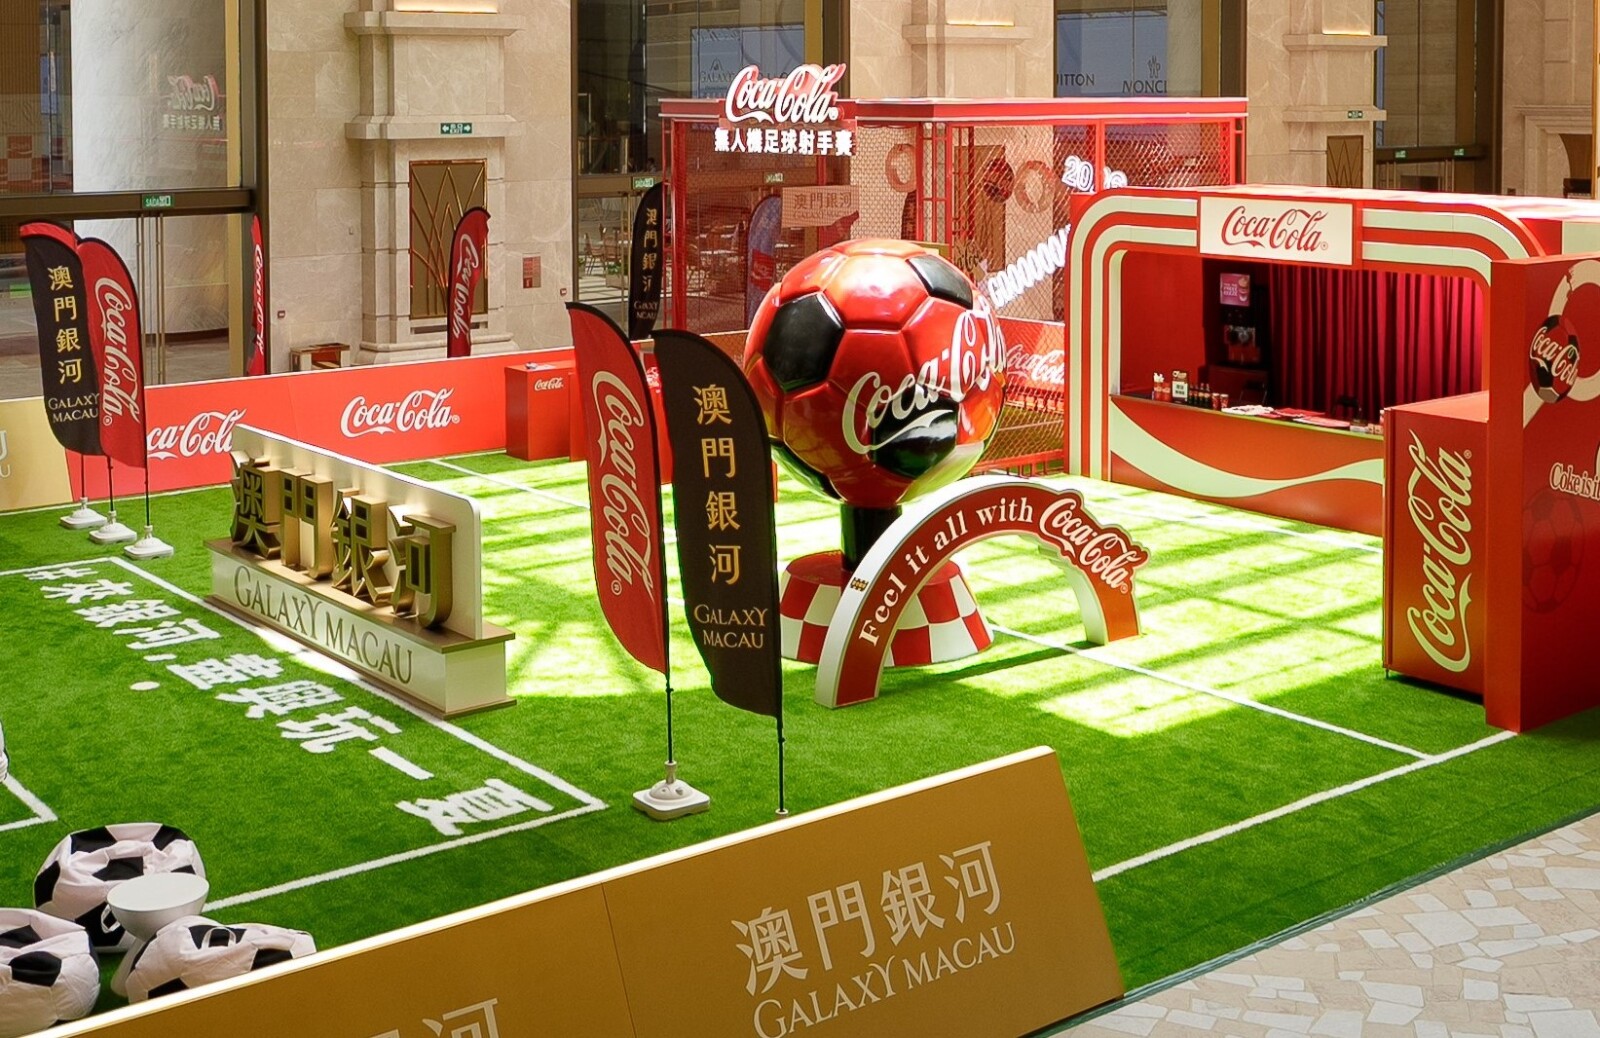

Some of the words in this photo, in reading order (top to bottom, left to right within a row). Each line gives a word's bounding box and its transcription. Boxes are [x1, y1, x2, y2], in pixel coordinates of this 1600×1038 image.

[1221, 205, 1328, 252] Coca-Cola
[48, 265, 83, 385] 澳門銀河
[48, 393, 99, 411] GALAXY
[52, 408, 98, 423] MACAU
[340, 387, 461, 438] Coca-Cola
[593, 370, 655, 605] Coca-Cola
[692, 383, 742, 586] 澳門銀河
[1550, 462, 1581, 495] Coke
[1580, 471, 1592, 498] is
[229, 450, 456, 630] 澳門銀河
[859, 572, 908, 646] Feel
[904, 544, 930, 575] it
[933, 510, 969, 551] all
[975, 497, 1034, 527] with
[1039, 498, 1142, 595] Coca-Cola
[1407, 428, 1473, 673] Coca-Cola
[234, 565, 323, 641] GALAXY
[325, 610, 414, 685] MACAU
[694, 604, 769, 627] GALAXY
[703, 629, 764, 652] MACAU
[730, 840, 1001, 997] 澳門銀河
[753, 955, 898, 1038] GALAXY
[901, 921, 1016, 990] MACAU
